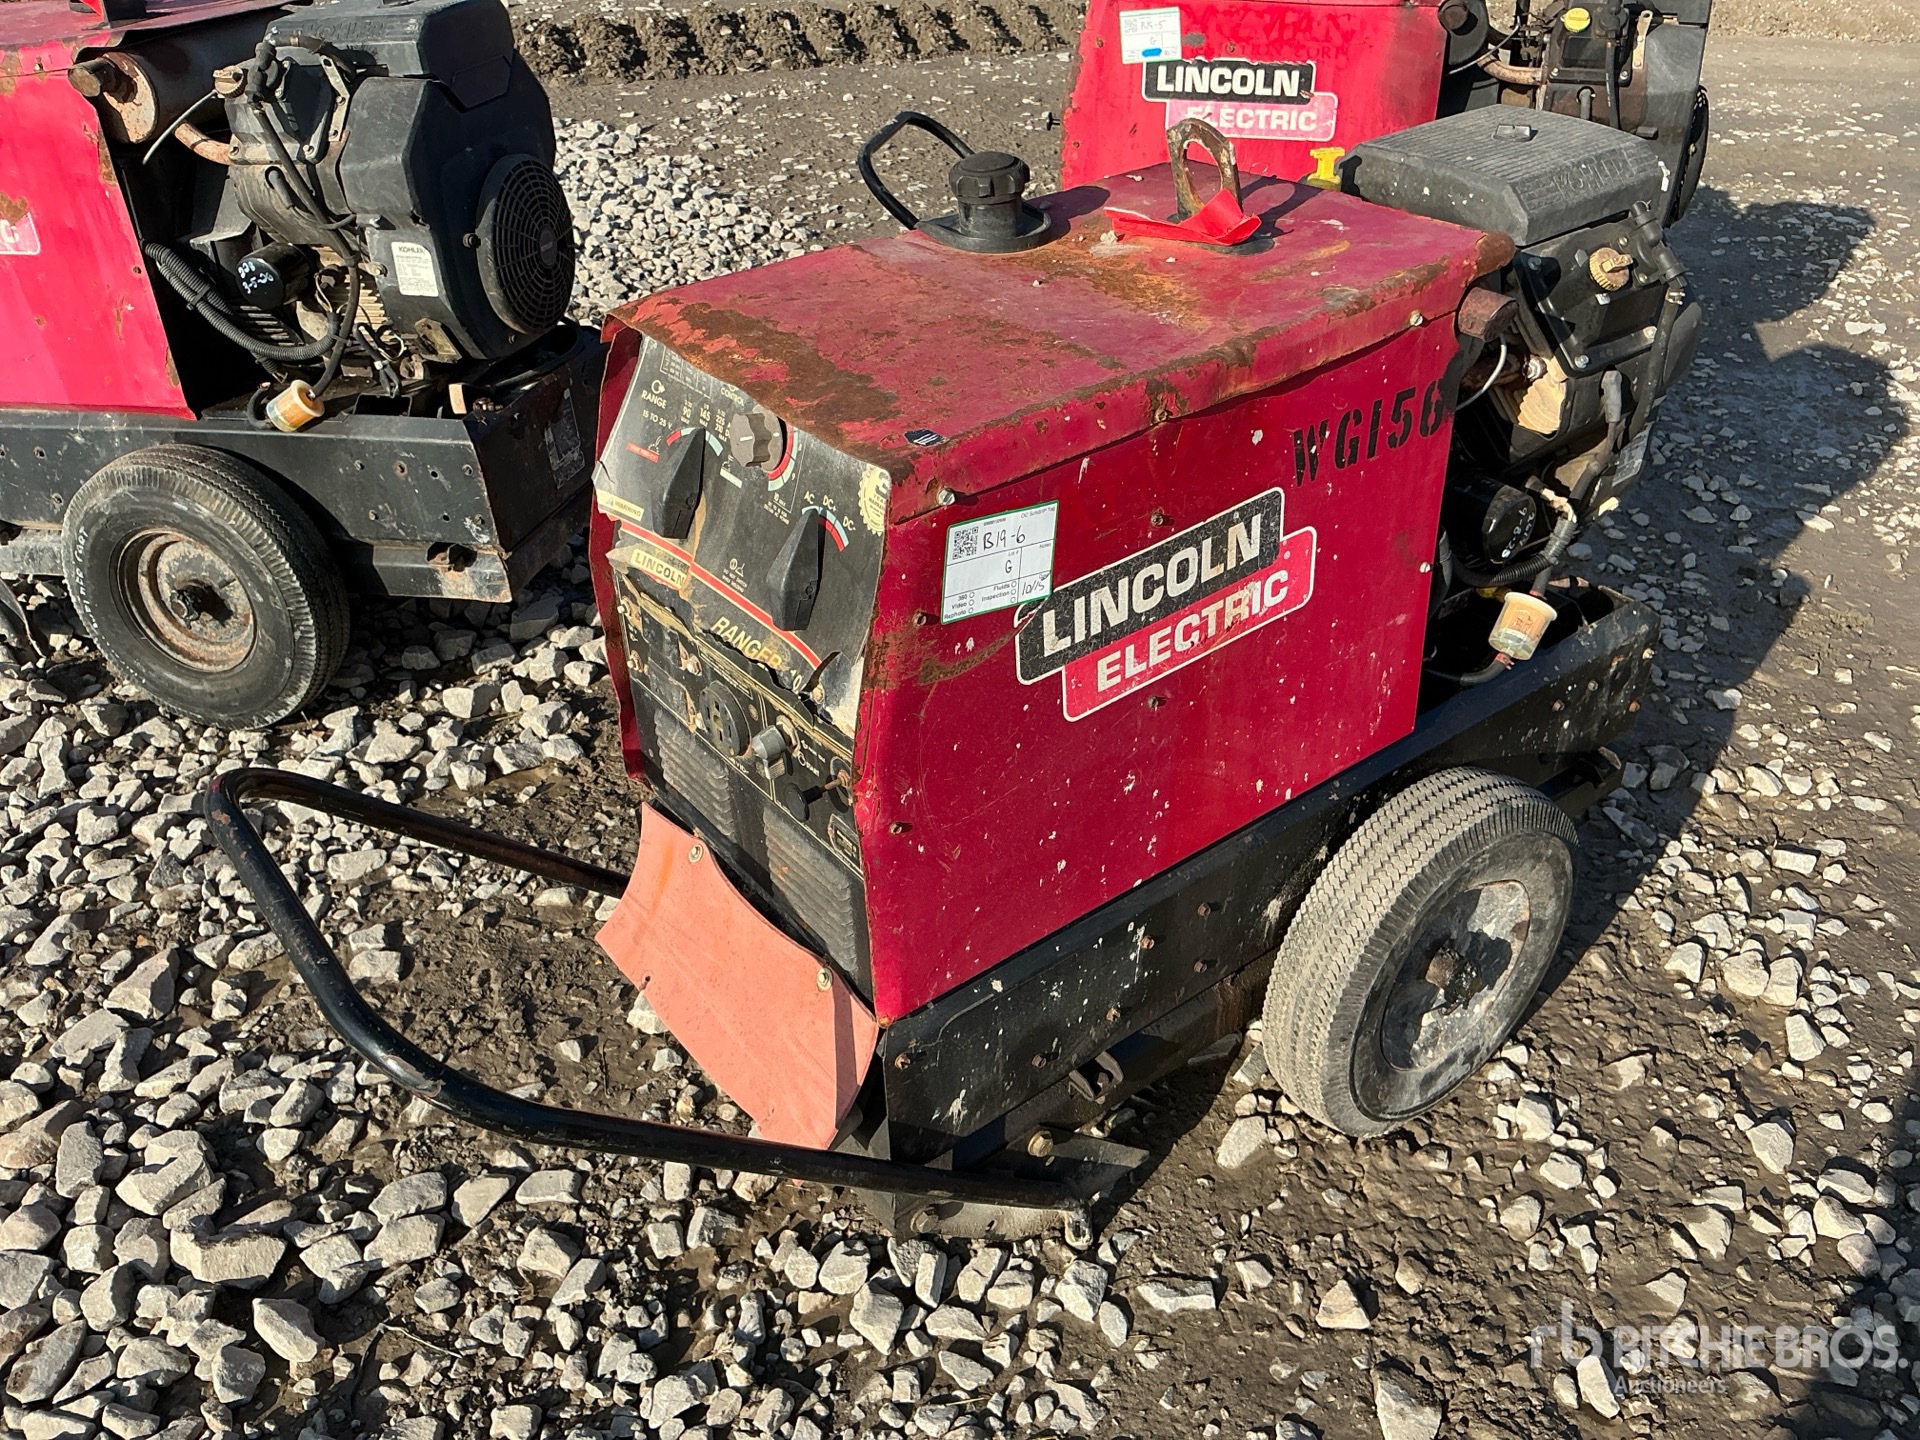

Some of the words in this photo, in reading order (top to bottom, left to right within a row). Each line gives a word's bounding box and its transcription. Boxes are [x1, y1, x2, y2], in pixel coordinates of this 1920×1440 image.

[1156, 65, 1300, 97] LINCOLN
[1186, 105, 1318, 132] ELECTRIC
[398, 246, 426, 255] KOHLER
[641, 390, 667, 410] RANGE
[720, 387, 745, 407] CONTROL
[642, 409, 650, 418] 15
[650, 412, 659, 422] TO
[658, 417, 667, 427] 25
[682, 406, 691, 419] 90
[700, 408, 711, 422] 145
[803, 490, 815, 505] AC
[822, 494, 837, 512] DC+
[614, 501, 641, 517] WARNING
[982, 525, 1026, 551] B19-6
[635, 552, 687, 587] LINCOLN
[1004, 560, 1013, 574] G
[992, 583, 1011, 592] Fluids
[1021, 579, 1046, 596] 10/15
[1042, 513, 1262, 658] LINCOLN
[981, 590, 1010, 602] Inspection
[951, 601, 968, 610] Video
[943, 610, 967, 620] Rephoto
[1096, 570, 1290, 694] ELECTRIC
[710, 616, 783, 669] RANGER
